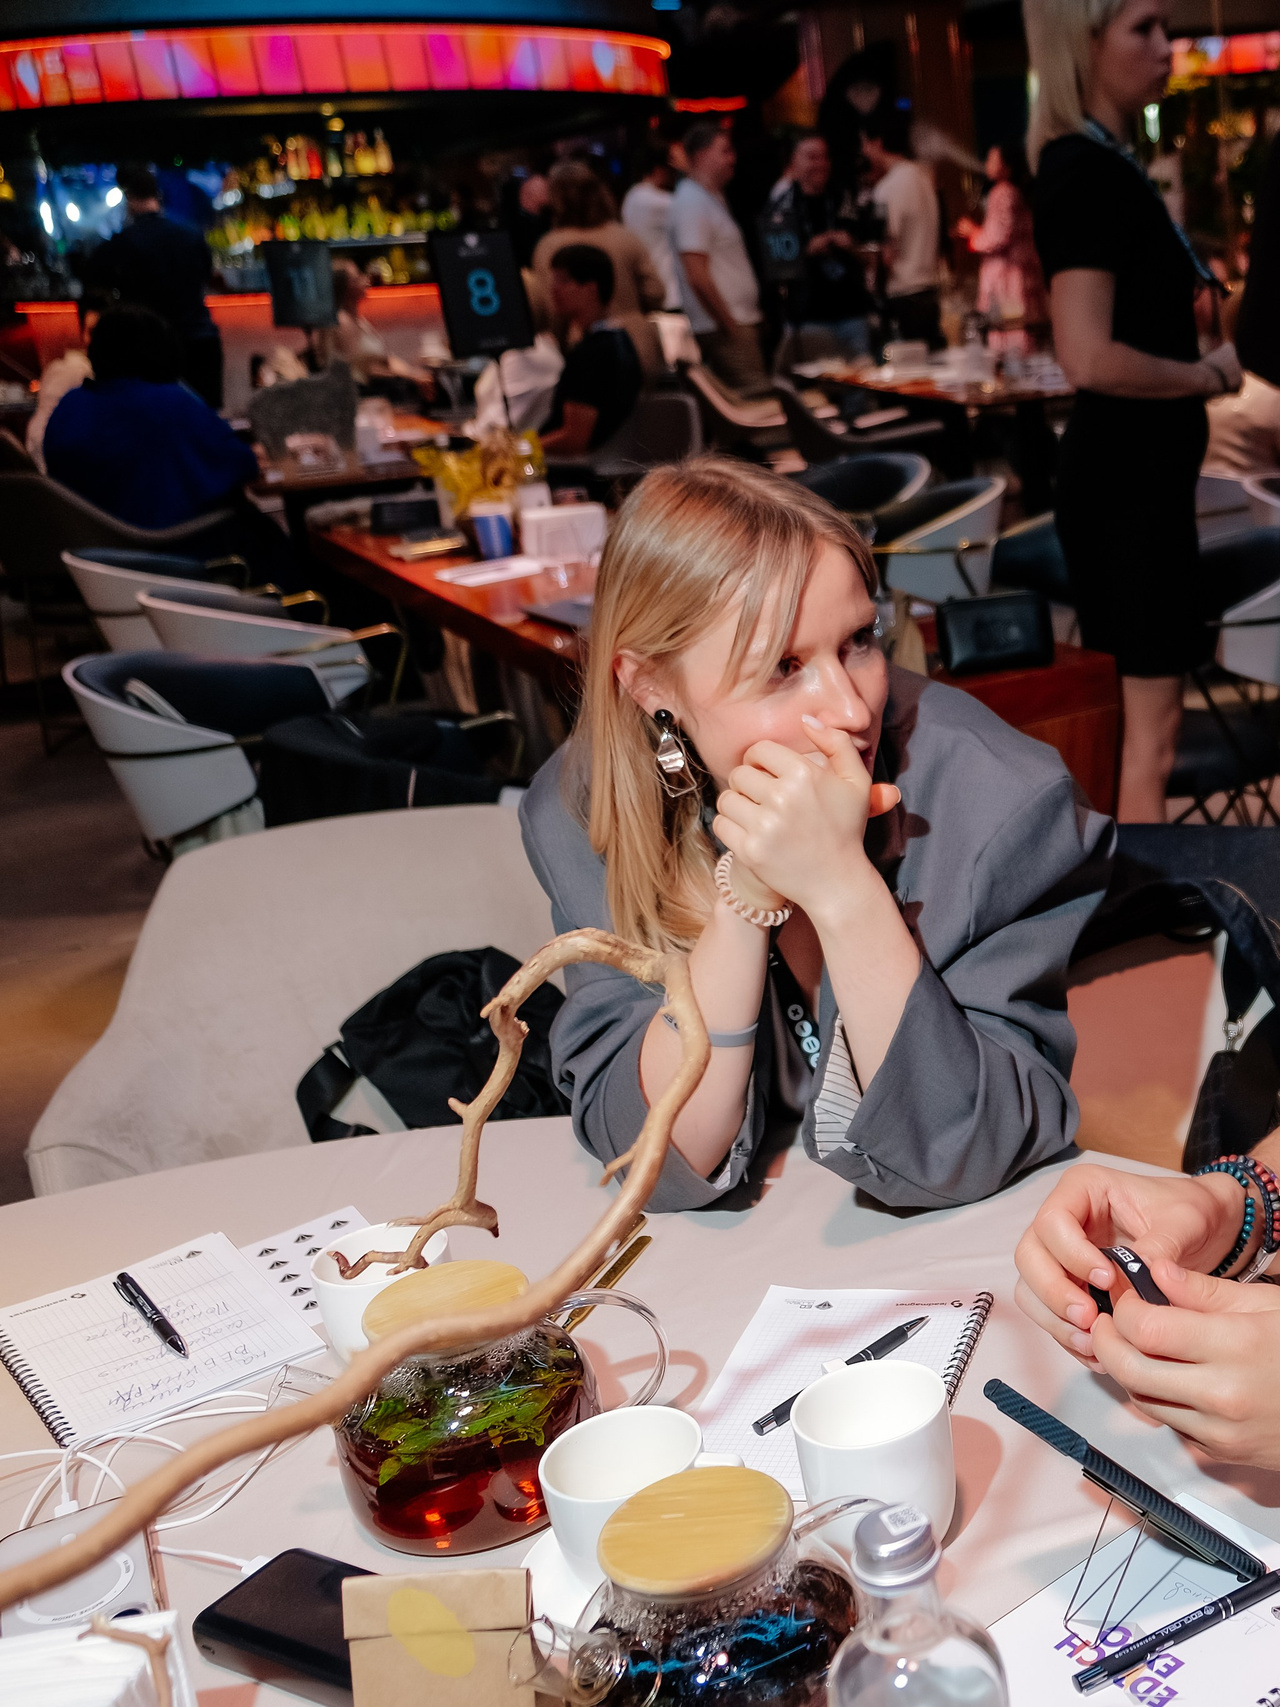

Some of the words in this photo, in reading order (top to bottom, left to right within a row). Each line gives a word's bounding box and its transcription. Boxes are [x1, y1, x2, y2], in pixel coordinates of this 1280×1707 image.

[765, 231, 800, 261] 10
[467, 268, 501, 316] 8
[1155, 1610, 1204, 1637] EDGLOBAL
